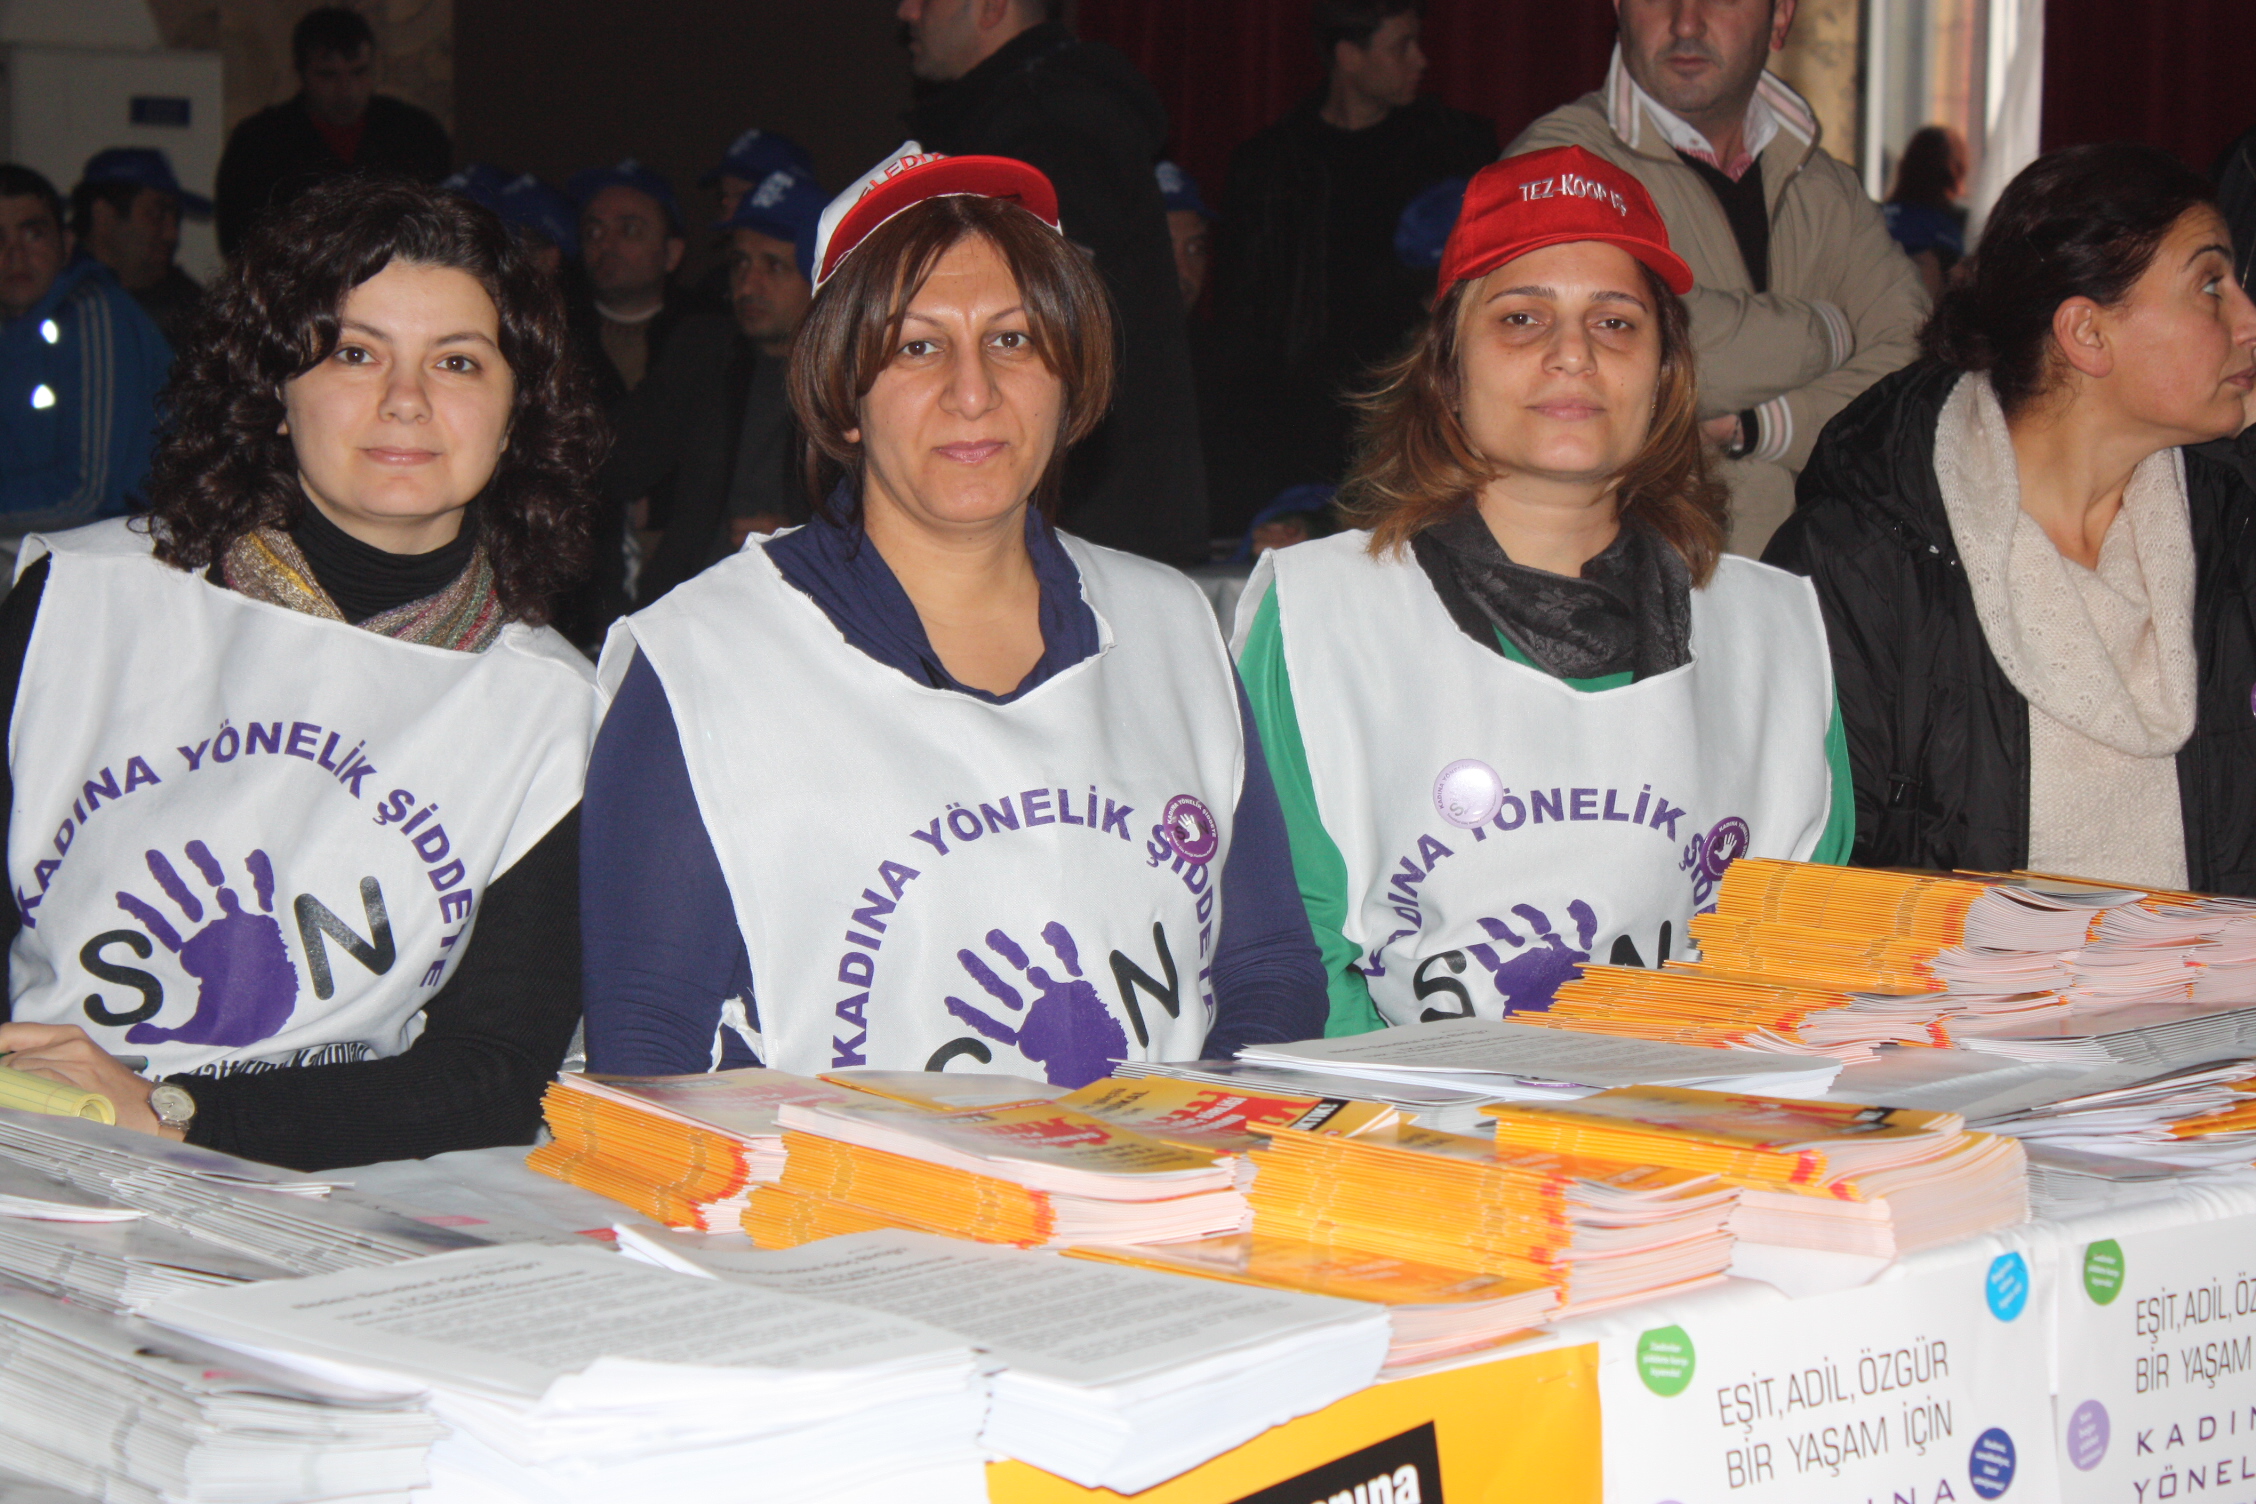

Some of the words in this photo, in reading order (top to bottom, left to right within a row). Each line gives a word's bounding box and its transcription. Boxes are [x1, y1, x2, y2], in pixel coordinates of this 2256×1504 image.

[17, 755, 162, 929] KADINA
[177, 718, 377, 800] YÖNELİK
[373, 789, 474, 989] ŞİDDETE
[831, 859, 920, 1069] KADINA
[910, 784, 1135, 857] YÖNELİK
[1858, 1336, 1949, 1397] ÖZGÜR
[2136, 1347, 2170, 1394] BİR
[2180, 1336, 2252, 1390] YAŞAM
[1726, 1436, 1774, 1489] BİR
[1787, 1416, 1889, 1478] YAŞAM
[1902, 1395, 1952, 1456] İÇİN
